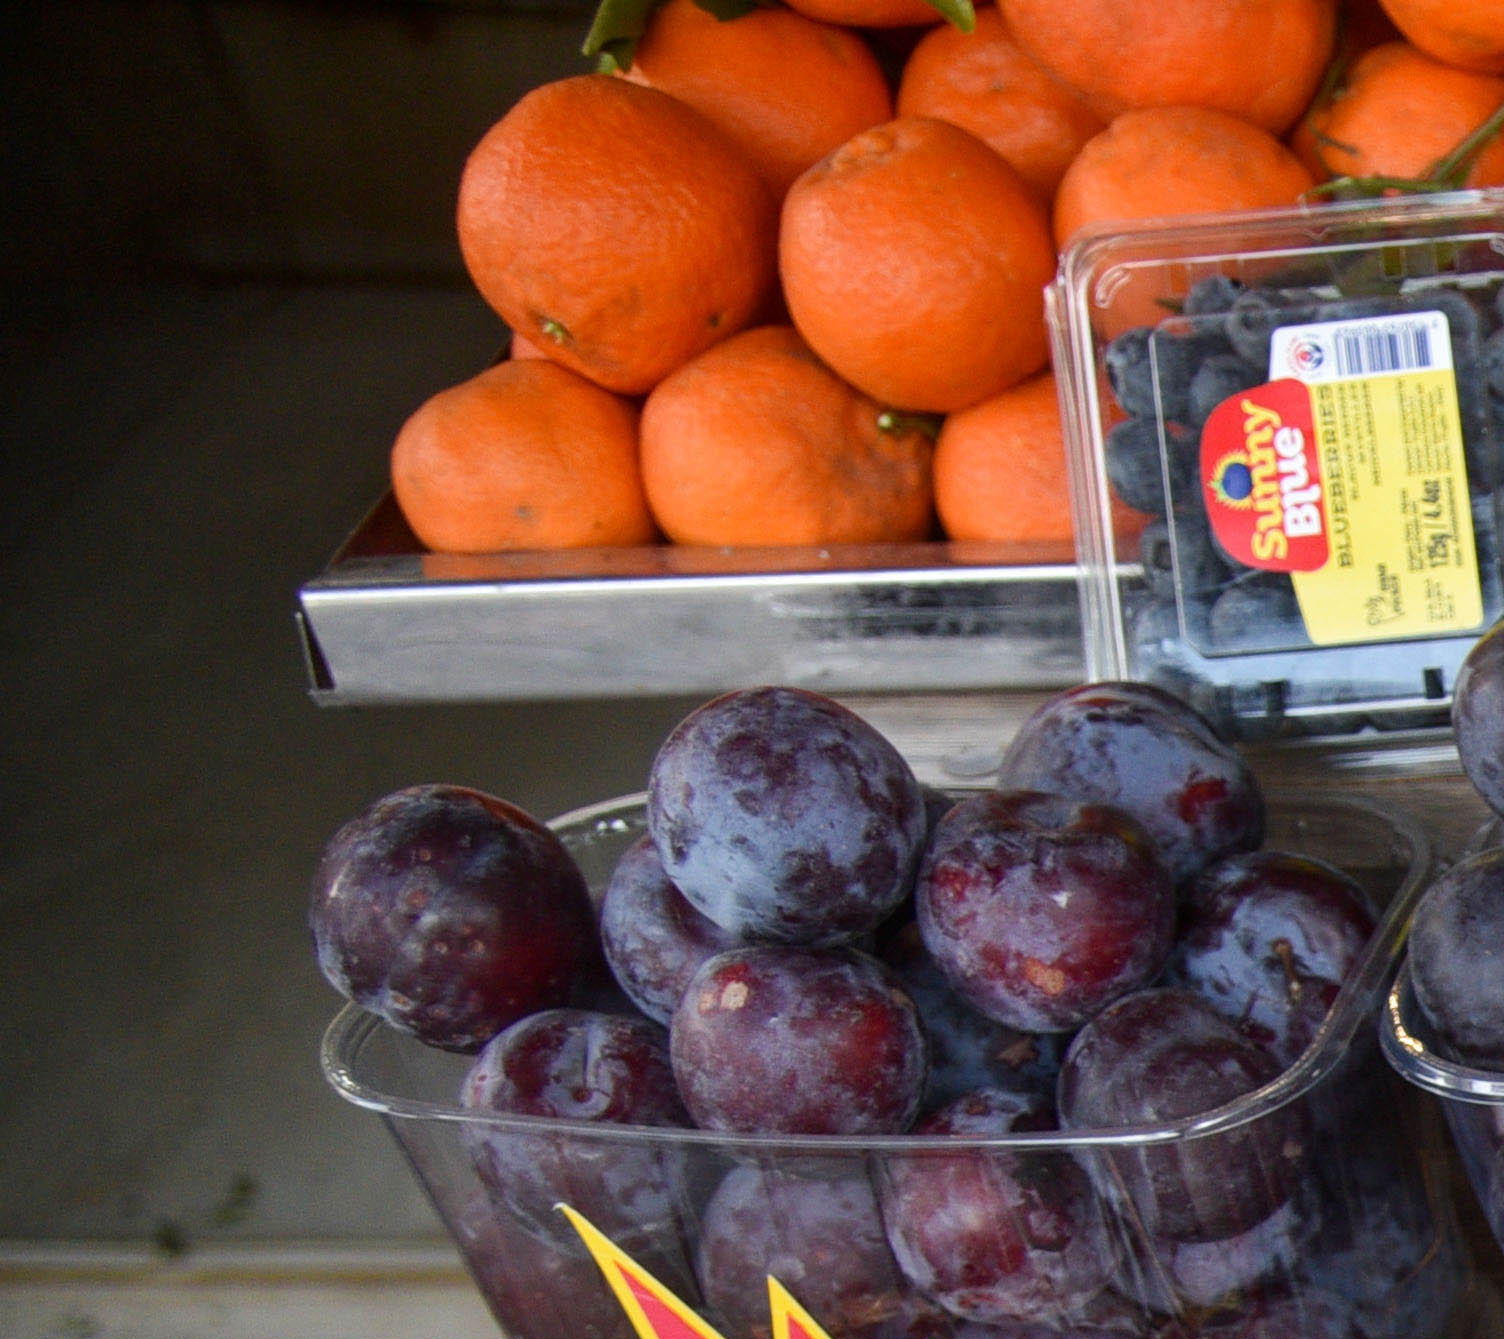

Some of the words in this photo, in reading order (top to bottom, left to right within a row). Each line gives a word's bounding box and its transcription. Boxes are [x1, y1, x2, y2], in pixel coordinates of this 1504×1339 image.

[1241, 398, 1287, 560] Sunny
[1274, 426, 1322, 537] Blue
[1319, 385, 1354, 568] BLUEBERRIES
